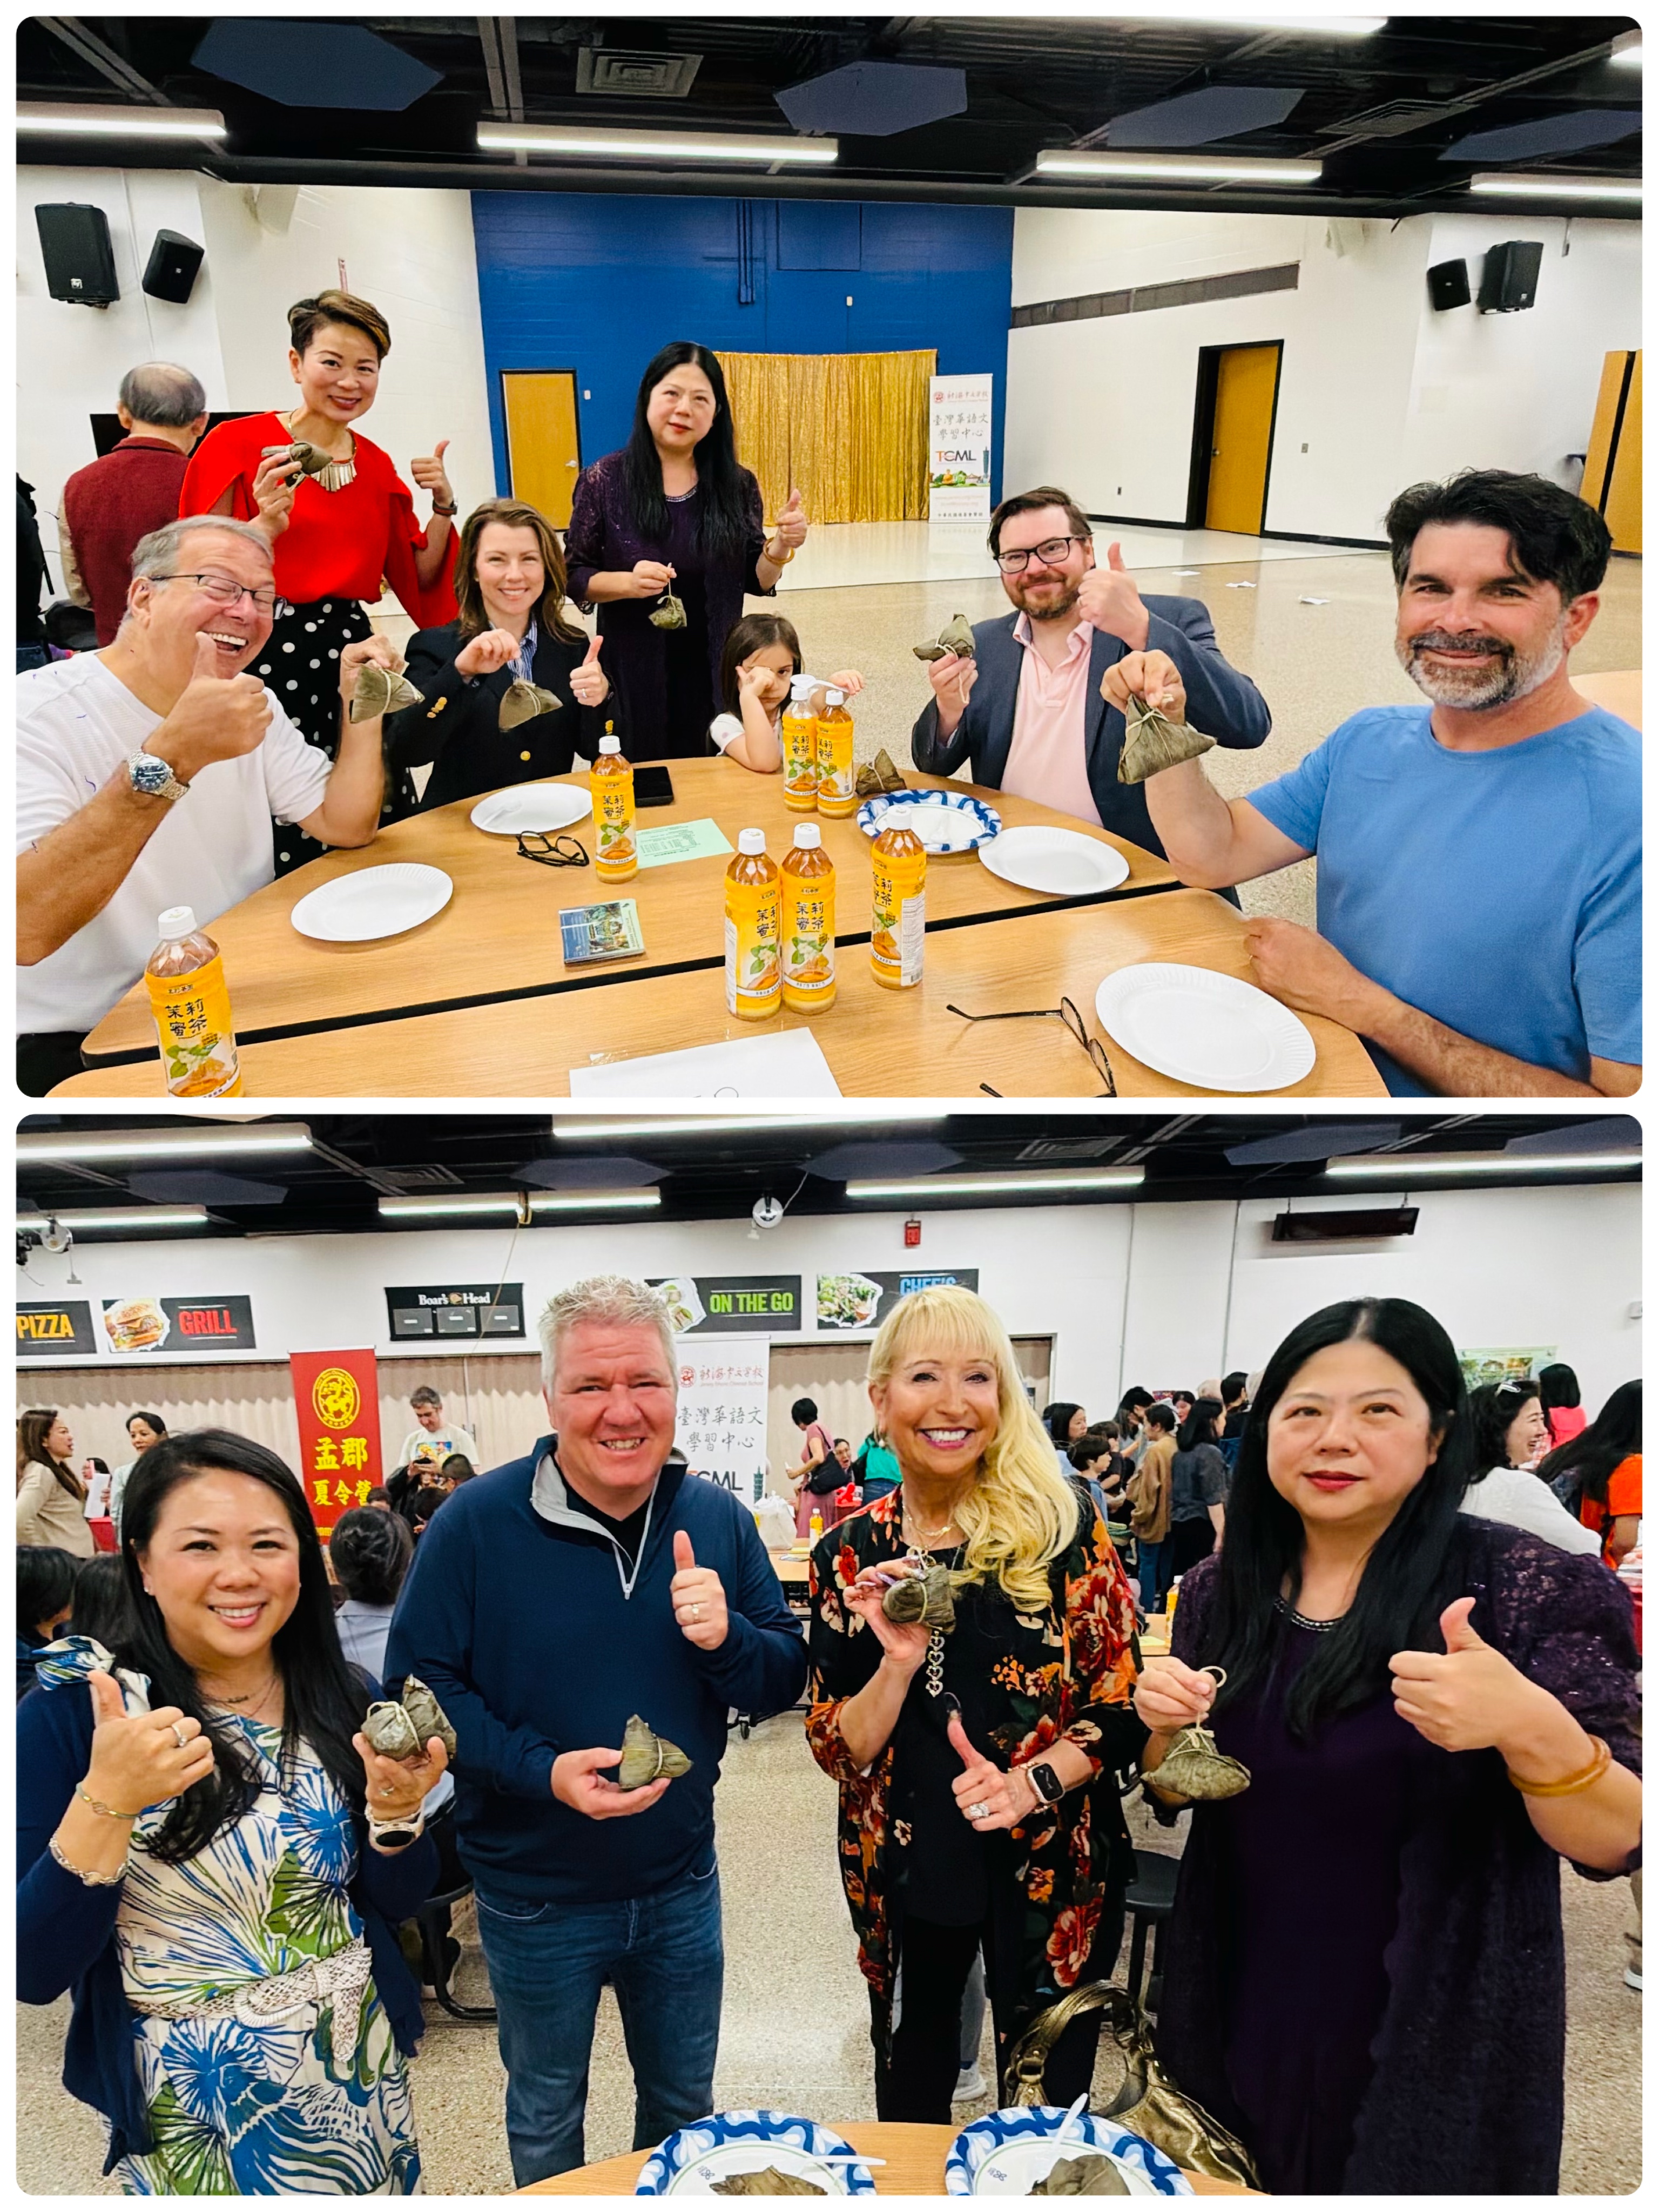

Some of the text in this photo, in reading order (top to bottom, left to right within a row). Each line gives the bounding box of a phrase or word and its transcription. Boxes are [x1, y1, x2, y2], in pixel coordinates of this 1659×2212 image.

[933, 413, 989, 426] 臺灣華語文
[938, 428, 983, 441] 學習中心
[935, 450, 976, 462] TCML
[796, 901, 824, 914] 茉莉
[796, 916, 824, 930] 蜜茶
[165, 998, 204, 1019] 茉莉
[170, 1014, 207, 1036] 蜜茶
[418, 1292, 491, 1305] Boar's Head
[710, 1292, 793, 1313] ON THE GO
[16, 1314, 75, 1339] PIZZA
[179, 1309, 238, 1335] GRILL
[678, 1405, 764, 1426] 臺灣華語文
[686, 1431, 755, 1453] 學習中心
[314, 1437, 368, 1471] 孟郡
[686, 1470, 744, 1491] ML
[313, 1479, 372, 1506] 夏令營
